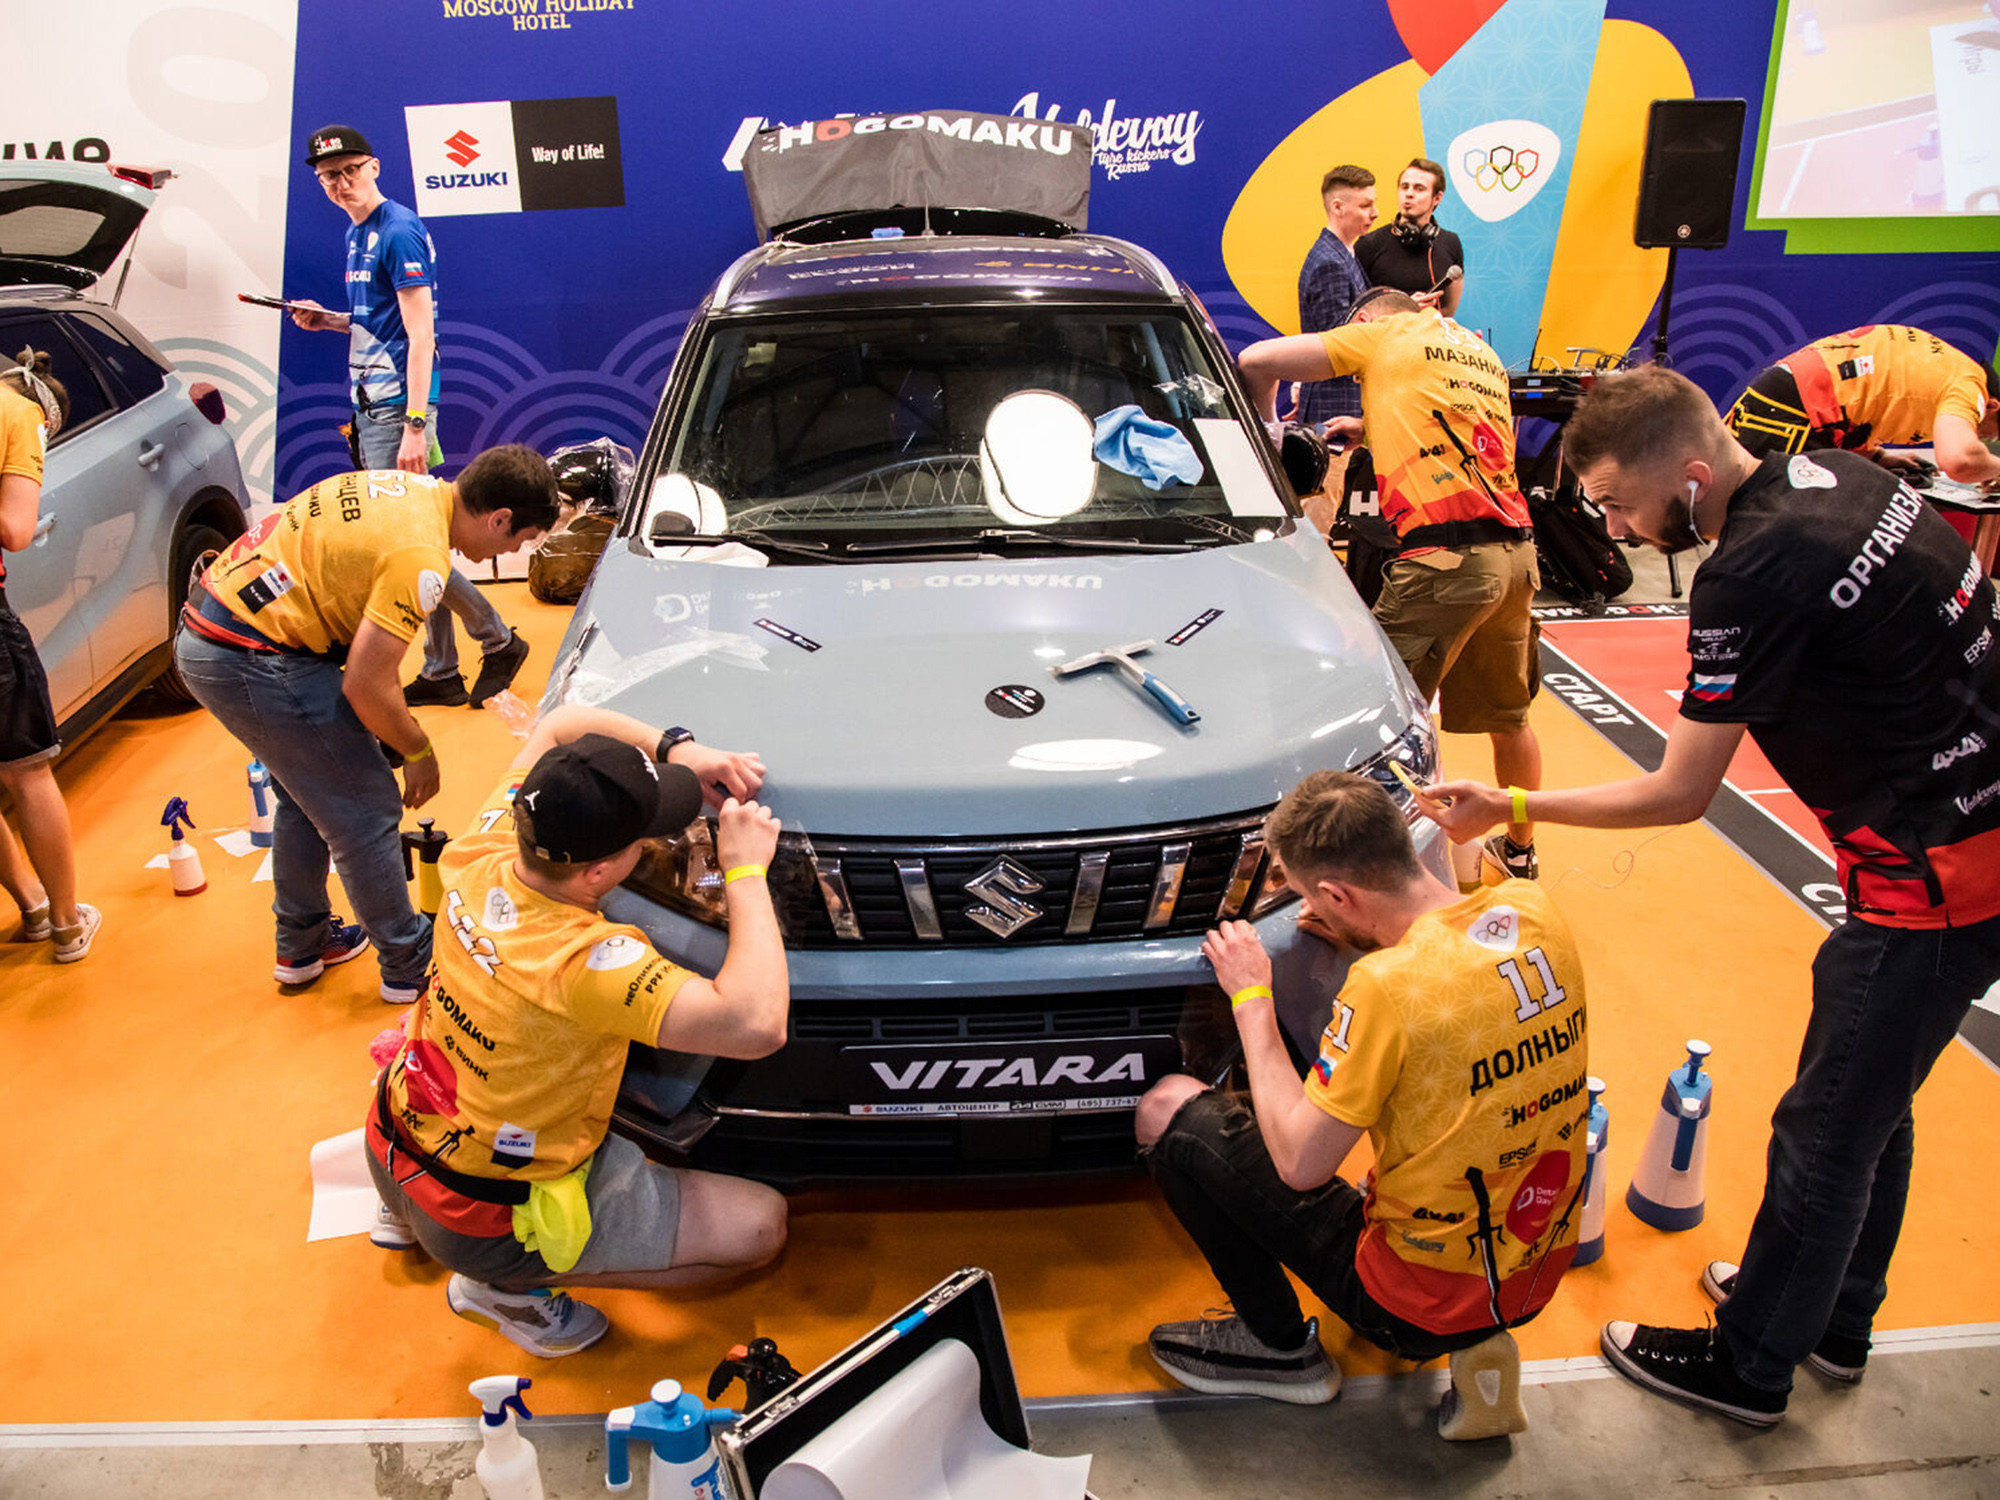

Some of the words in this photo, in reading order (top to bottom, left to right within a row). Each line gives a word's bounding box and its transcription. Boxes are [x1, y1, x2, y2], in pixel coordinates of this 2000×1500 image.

[443, 0, 539, 18] MOSCOW
[513, 13, 571, 31] HOTEL
[778, 112, 1073, 156] HOGOMAKU
[531, 146, 558, 165] Way
[562, 146, 575, 160] of
[578, 144, 605, 160] Life!
[425, 172, 508, 190] SUZUKI
[1105, 161, 1151, 181] Russia
[1829, 478, 1923, 609] ОРГАНИЗА
[1543, 673, 1635, 725] СТАРТ
[1496, 946, 1567, 1024] 11
[869, 1052, 1146, 1090] VITARA
[875, 1105, 924, 1113] SUZUKI
[936, 1102, 1000, 1112] АВТОЦЕНТР
